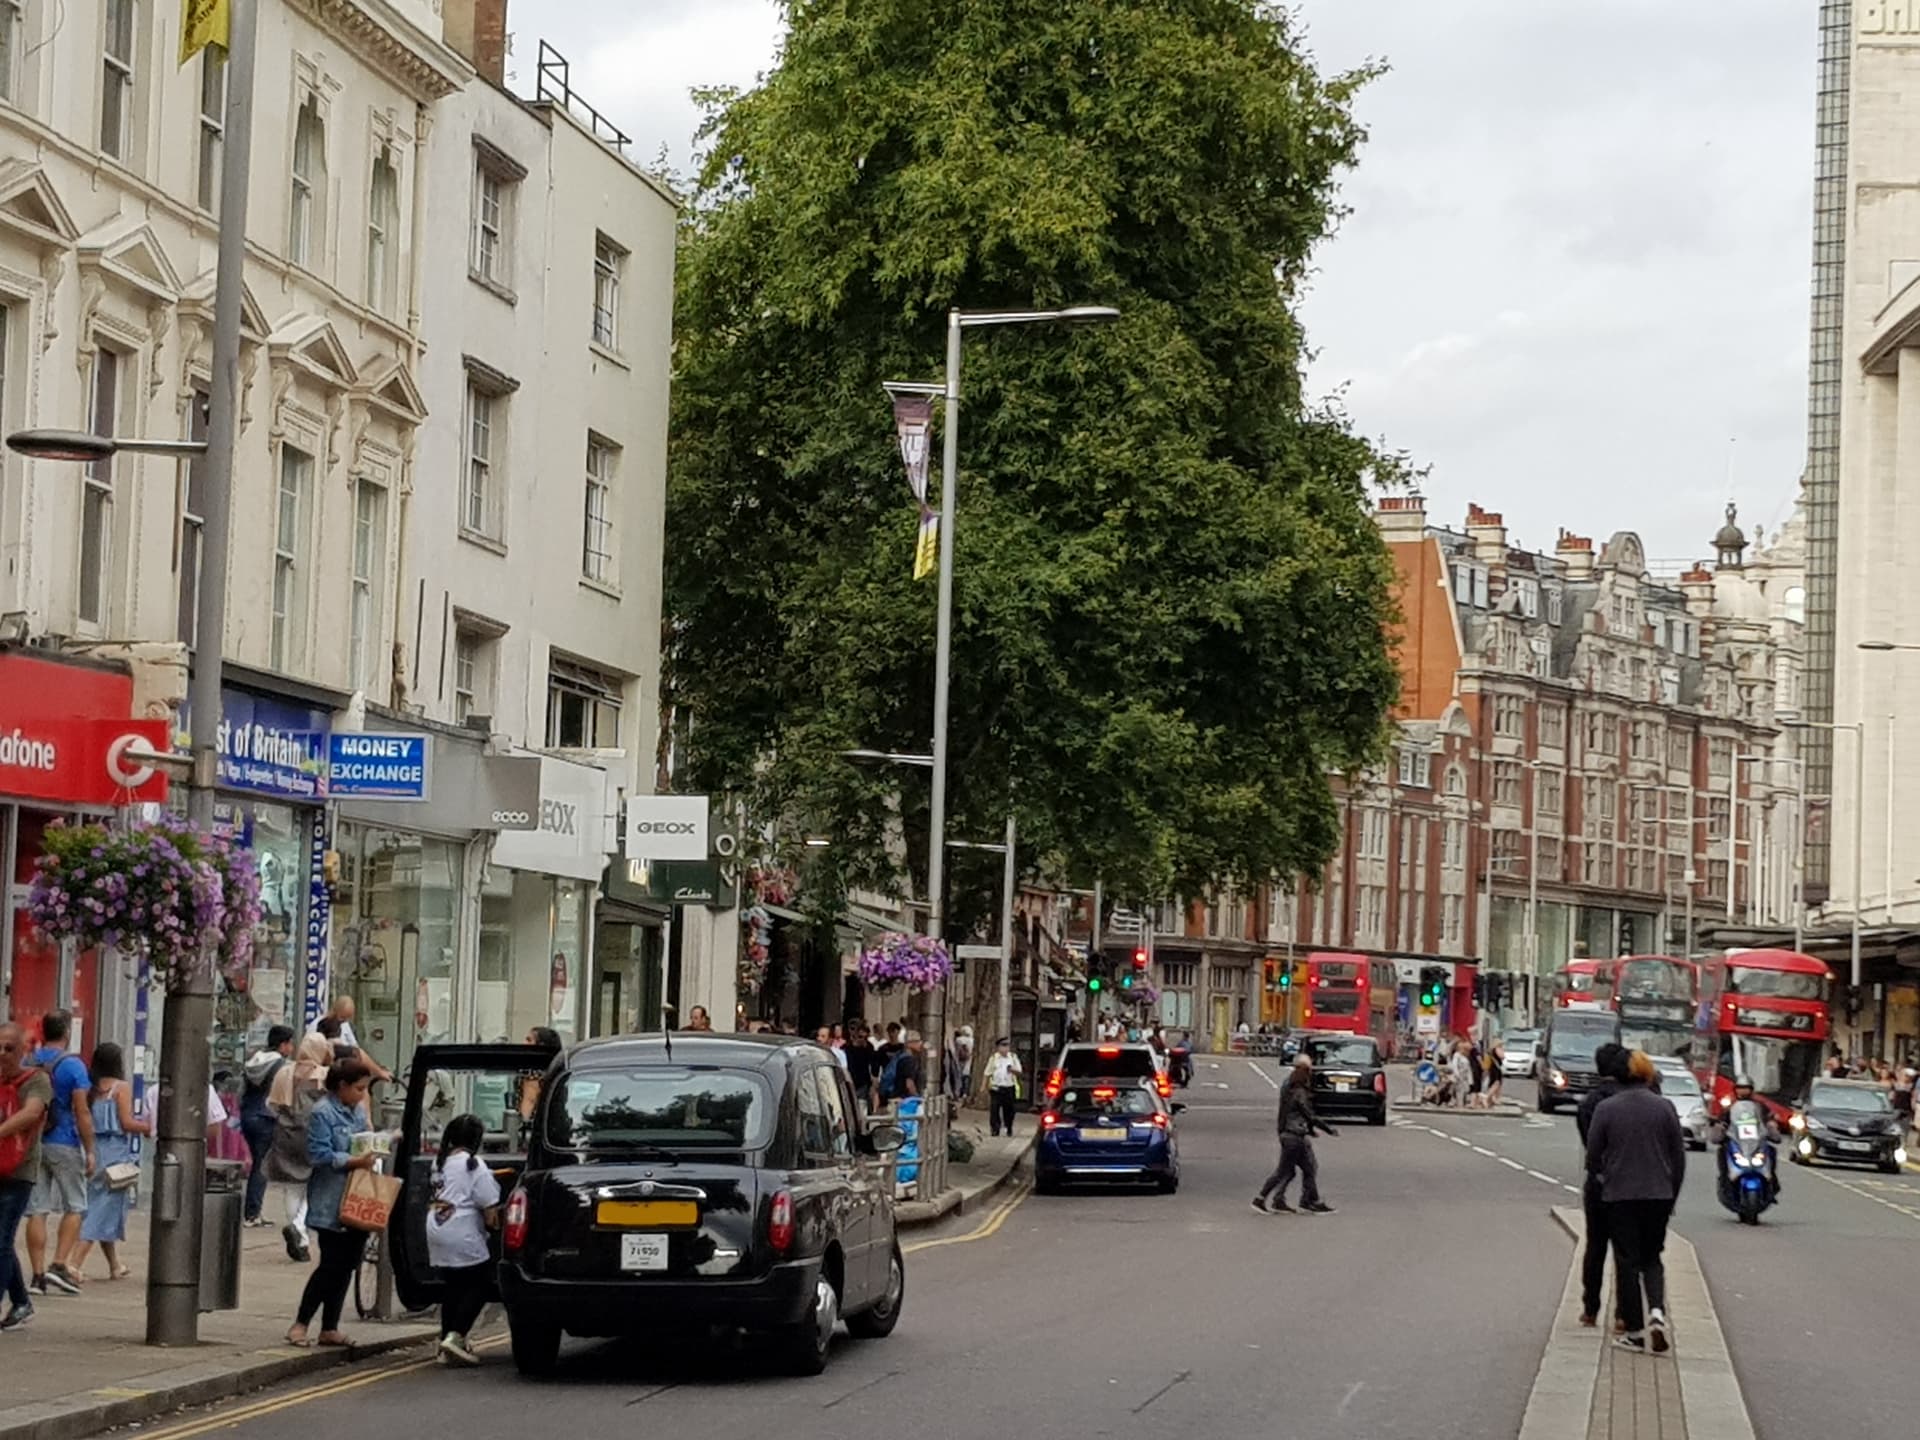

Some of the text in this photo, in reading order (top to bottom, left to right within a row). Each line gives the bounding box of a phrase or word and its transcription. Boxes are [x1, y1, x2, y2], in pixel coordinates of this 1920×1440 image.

[0, 727, 55, 771] afone
[234, 722, 251, 758] of
[254, 724, 300, 769] Britain
[341, 738, 412, 758] MONEY
[330, 763, 421, 782] EXCHANGE
[541, 799, 576, 835] EOX
[637, 822, 696, 834] GEOX
[304, 893, 321, 1022] ACCESSORIE
